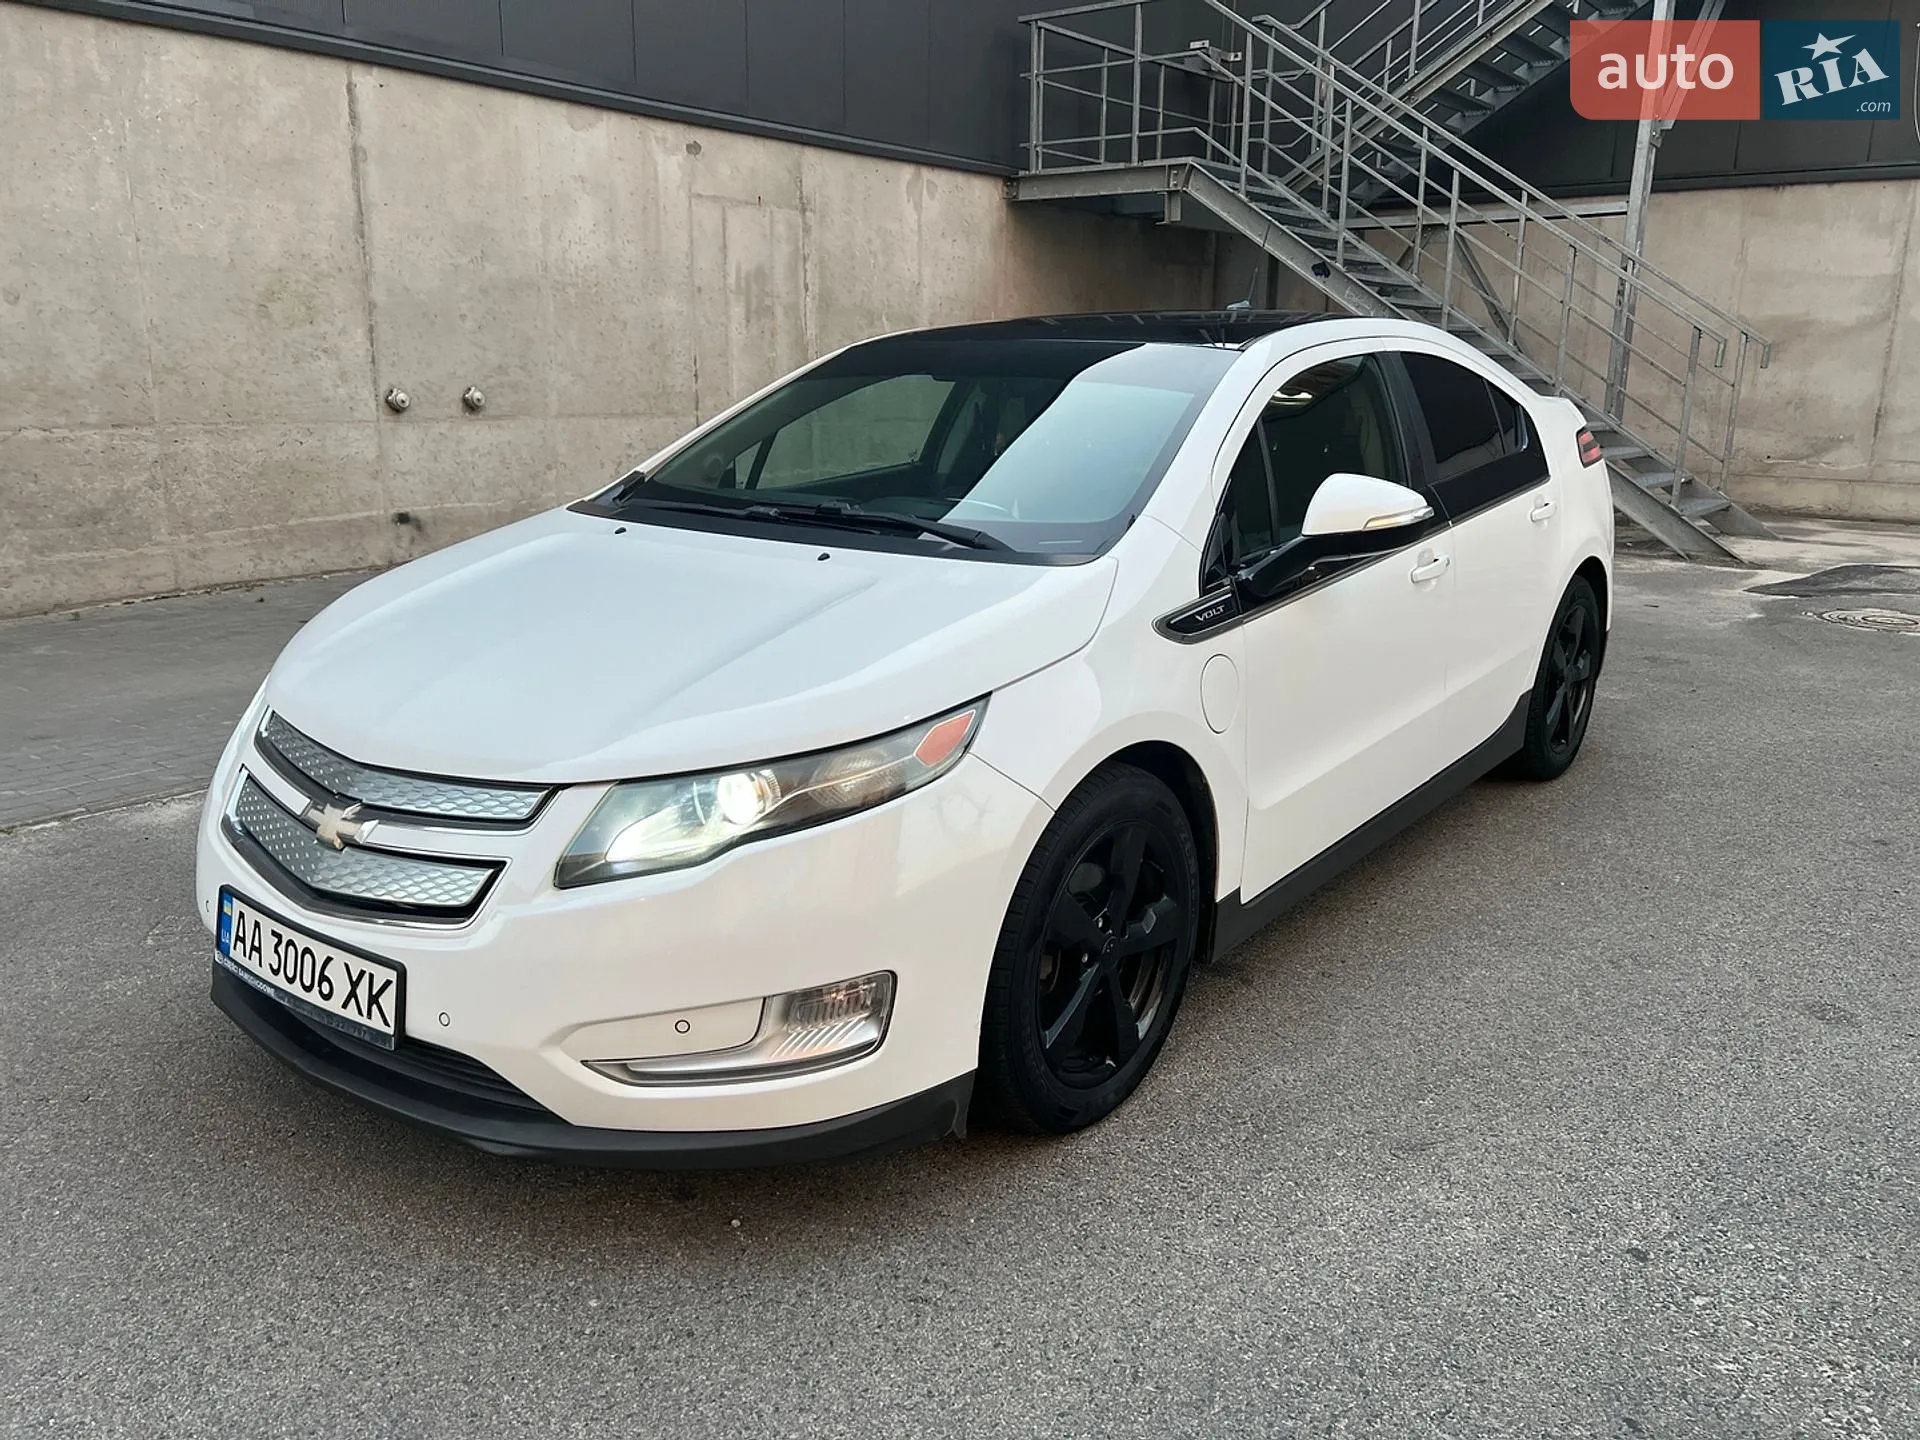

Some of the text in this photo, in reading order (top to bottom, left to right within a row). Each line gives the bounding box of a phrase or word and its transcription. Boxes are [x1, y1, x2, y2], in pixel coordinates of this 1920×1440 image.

[1194, 604, 1225, 621] VOLT
[233, 911, 263, 968] AA
[268, 929, 334, 1001] 3006
[341, 962, 393, 1028] XK
